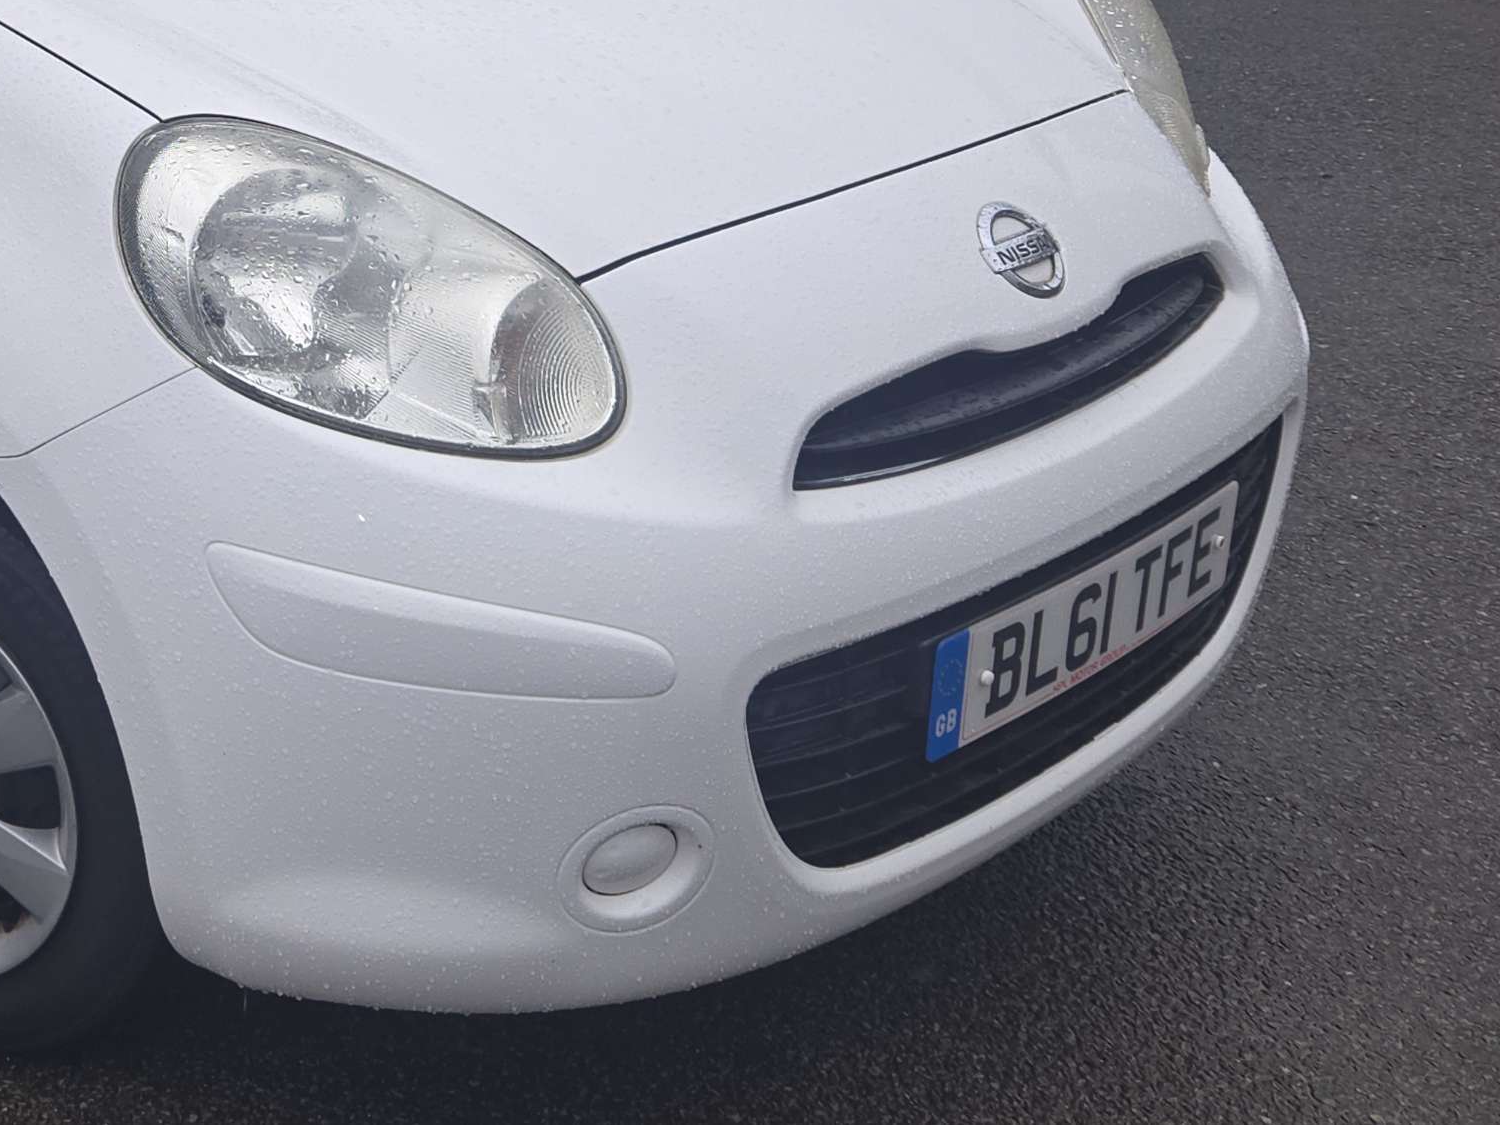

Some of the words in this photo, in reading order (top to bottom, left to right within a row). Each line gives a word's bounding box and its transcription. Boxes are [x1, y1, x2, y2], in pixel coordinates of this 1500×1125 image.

[984, 570, 1119, 719] BL61
[1135, 506, 1221, 633] TFE
[935, 707, 958, 738] GB
